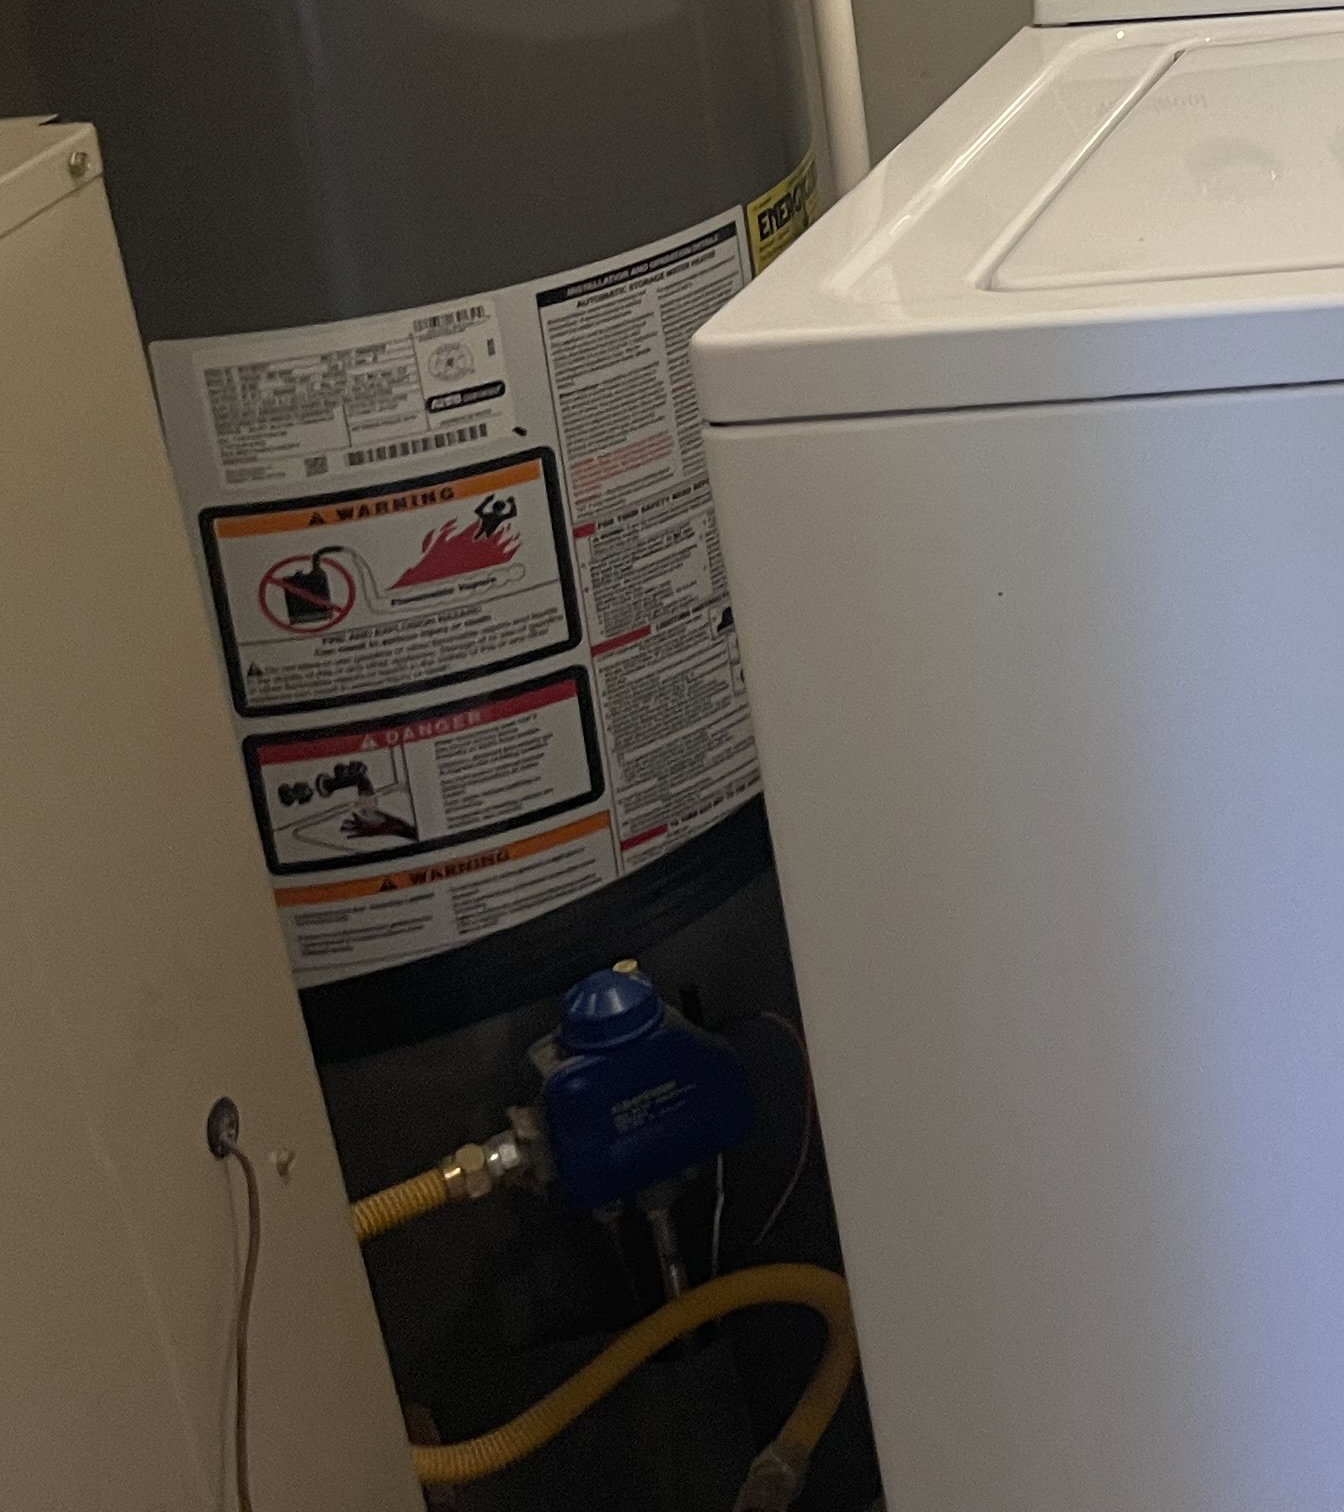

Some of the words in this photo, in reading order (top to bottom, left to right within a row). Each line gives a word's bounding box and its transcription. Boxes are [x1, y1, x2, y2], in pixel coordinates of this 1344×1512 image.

[336, 486, 455, 521] WARNING
[385, 710, 482, 745] DANGER
[409, 845, 510, 885] WARNING
